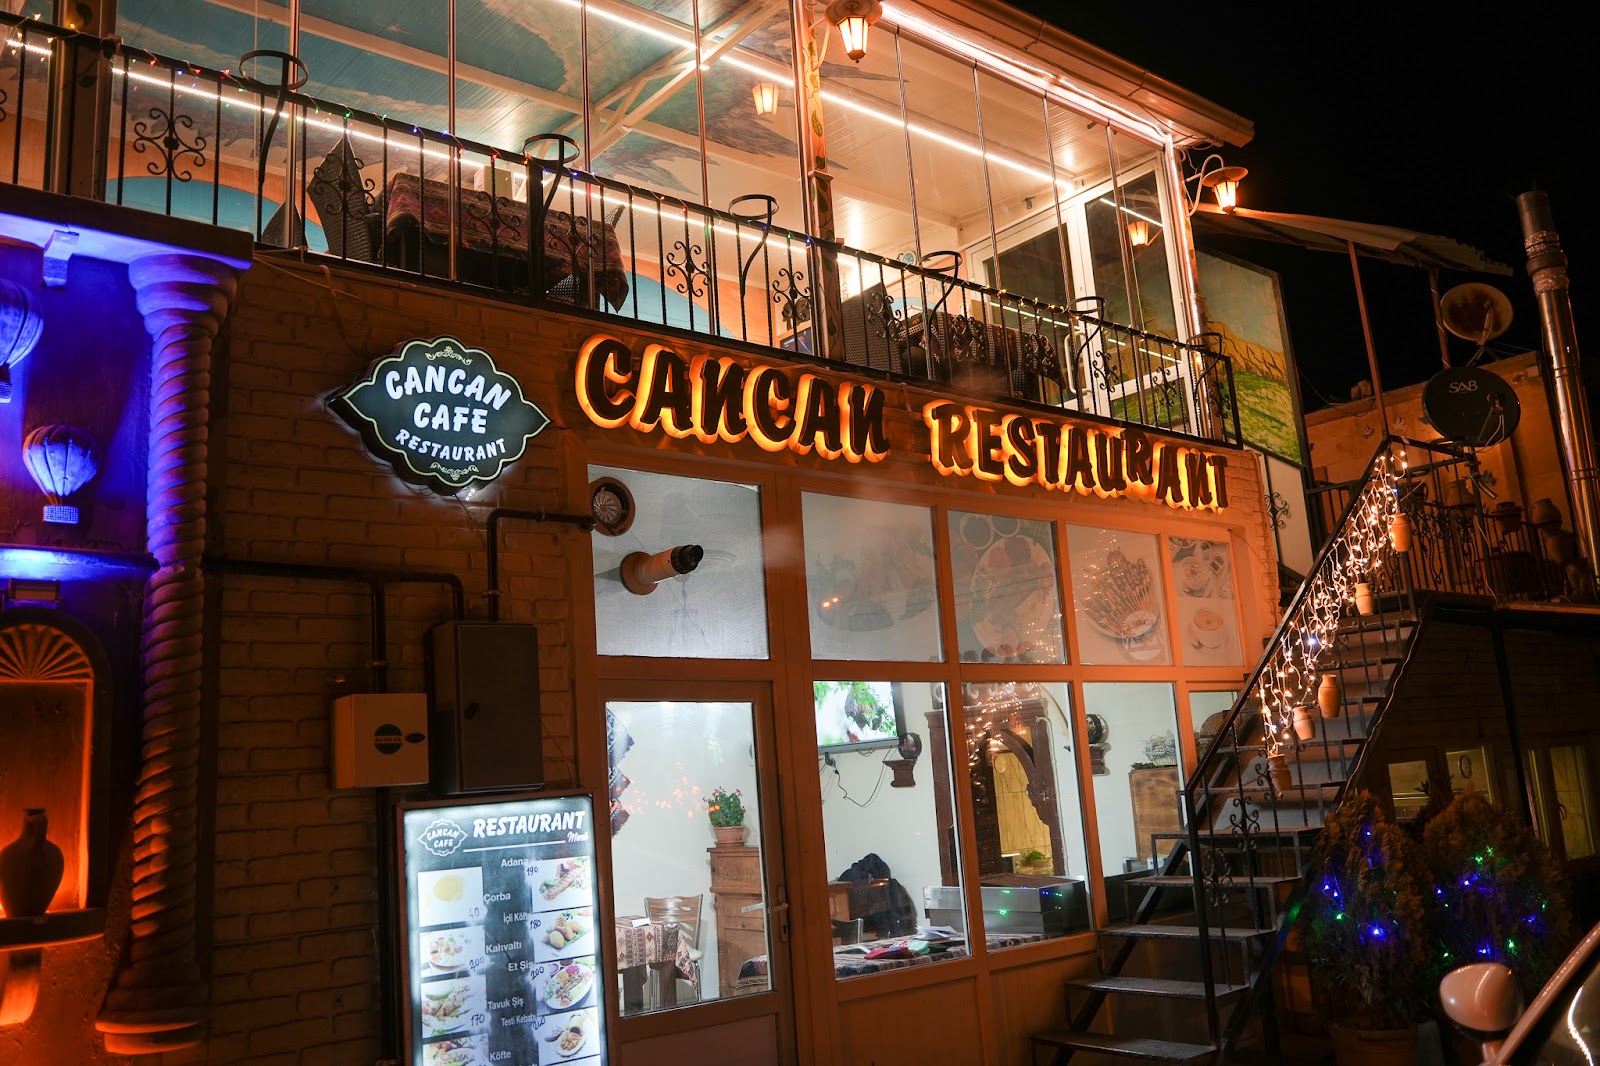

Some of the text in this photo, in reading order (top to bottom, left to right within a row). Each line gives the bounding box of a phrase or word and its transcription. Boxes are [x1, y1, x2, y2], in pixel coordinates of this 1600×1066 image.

[385, 365, 511, 411] CANCAN
[413, 402, 488, 434] CAFE
[576, 334, 1228, 514] CANCAN RESTAURANT
[395, 429, 506, 462] RESTAURANT
[473, 811, 586, 838] RESTAURANT
[426, 828, 460, 841] CANCAN
[434, 839, 454, 848] CAFE
[500, 858, 529, 868] Adana
[483, 892, 511, 904] Çorba
[485, 940, 522, 954] Kahvaltı
[508, 962, 518, 972] Et
[487, 996, 524, 1010] Tavuk Şiş
[490, 1050, 511, 1061] Köfte
